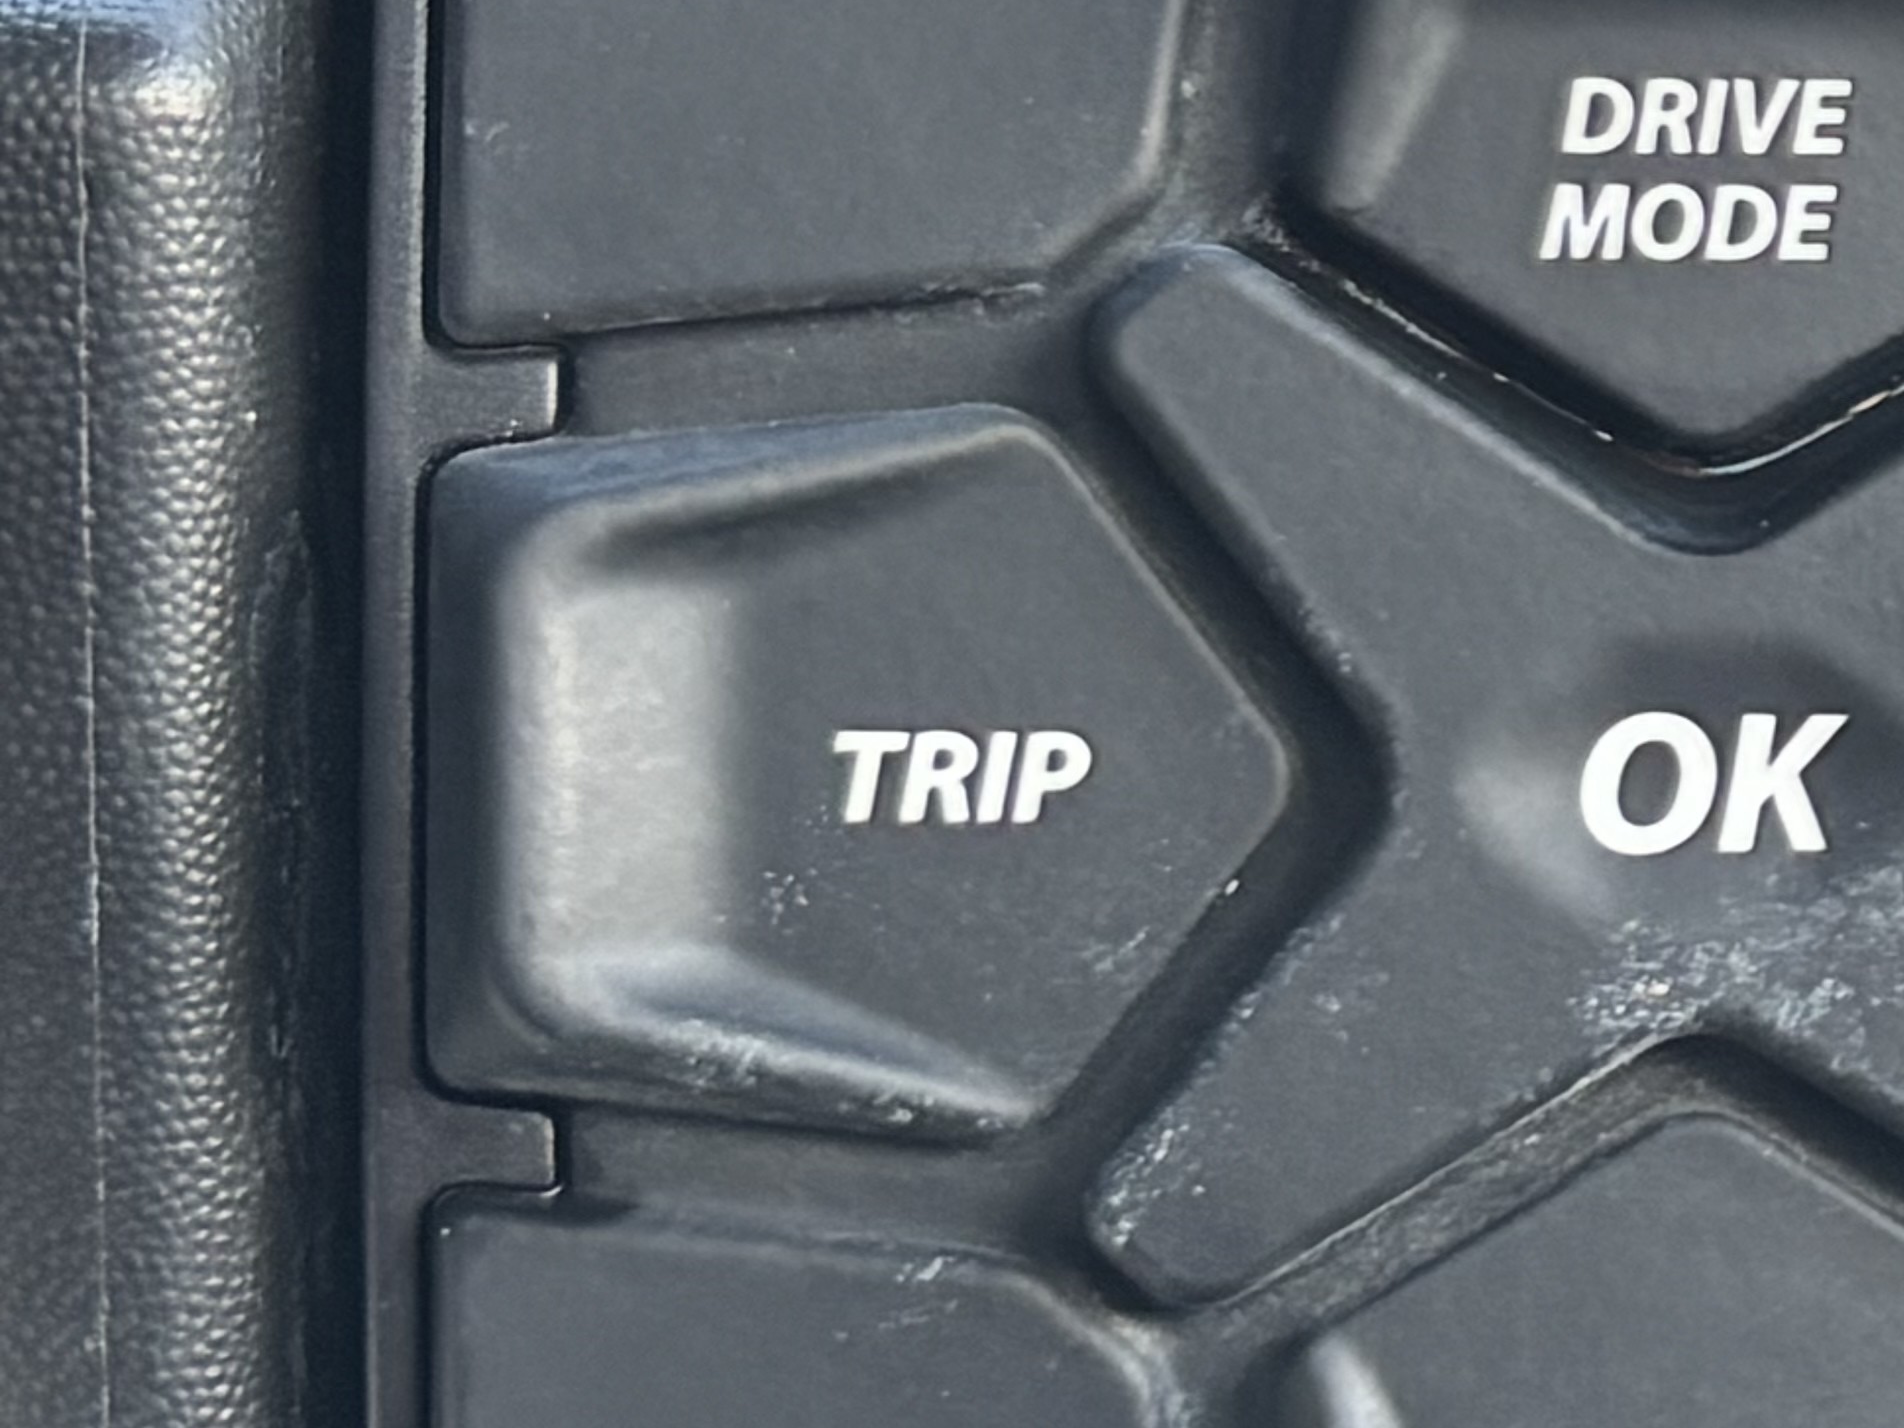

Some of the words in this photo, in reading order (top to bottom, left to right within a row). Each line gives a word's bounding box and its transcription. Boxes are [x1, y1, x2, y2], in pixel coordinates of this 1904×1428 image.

[1560, 75, 1853, 156] DRIVE
[1537, 181, 1839, 262] MODE
[830, 729, 1093, 825] TRIP
[1578, 710, 1848, 857] OK
